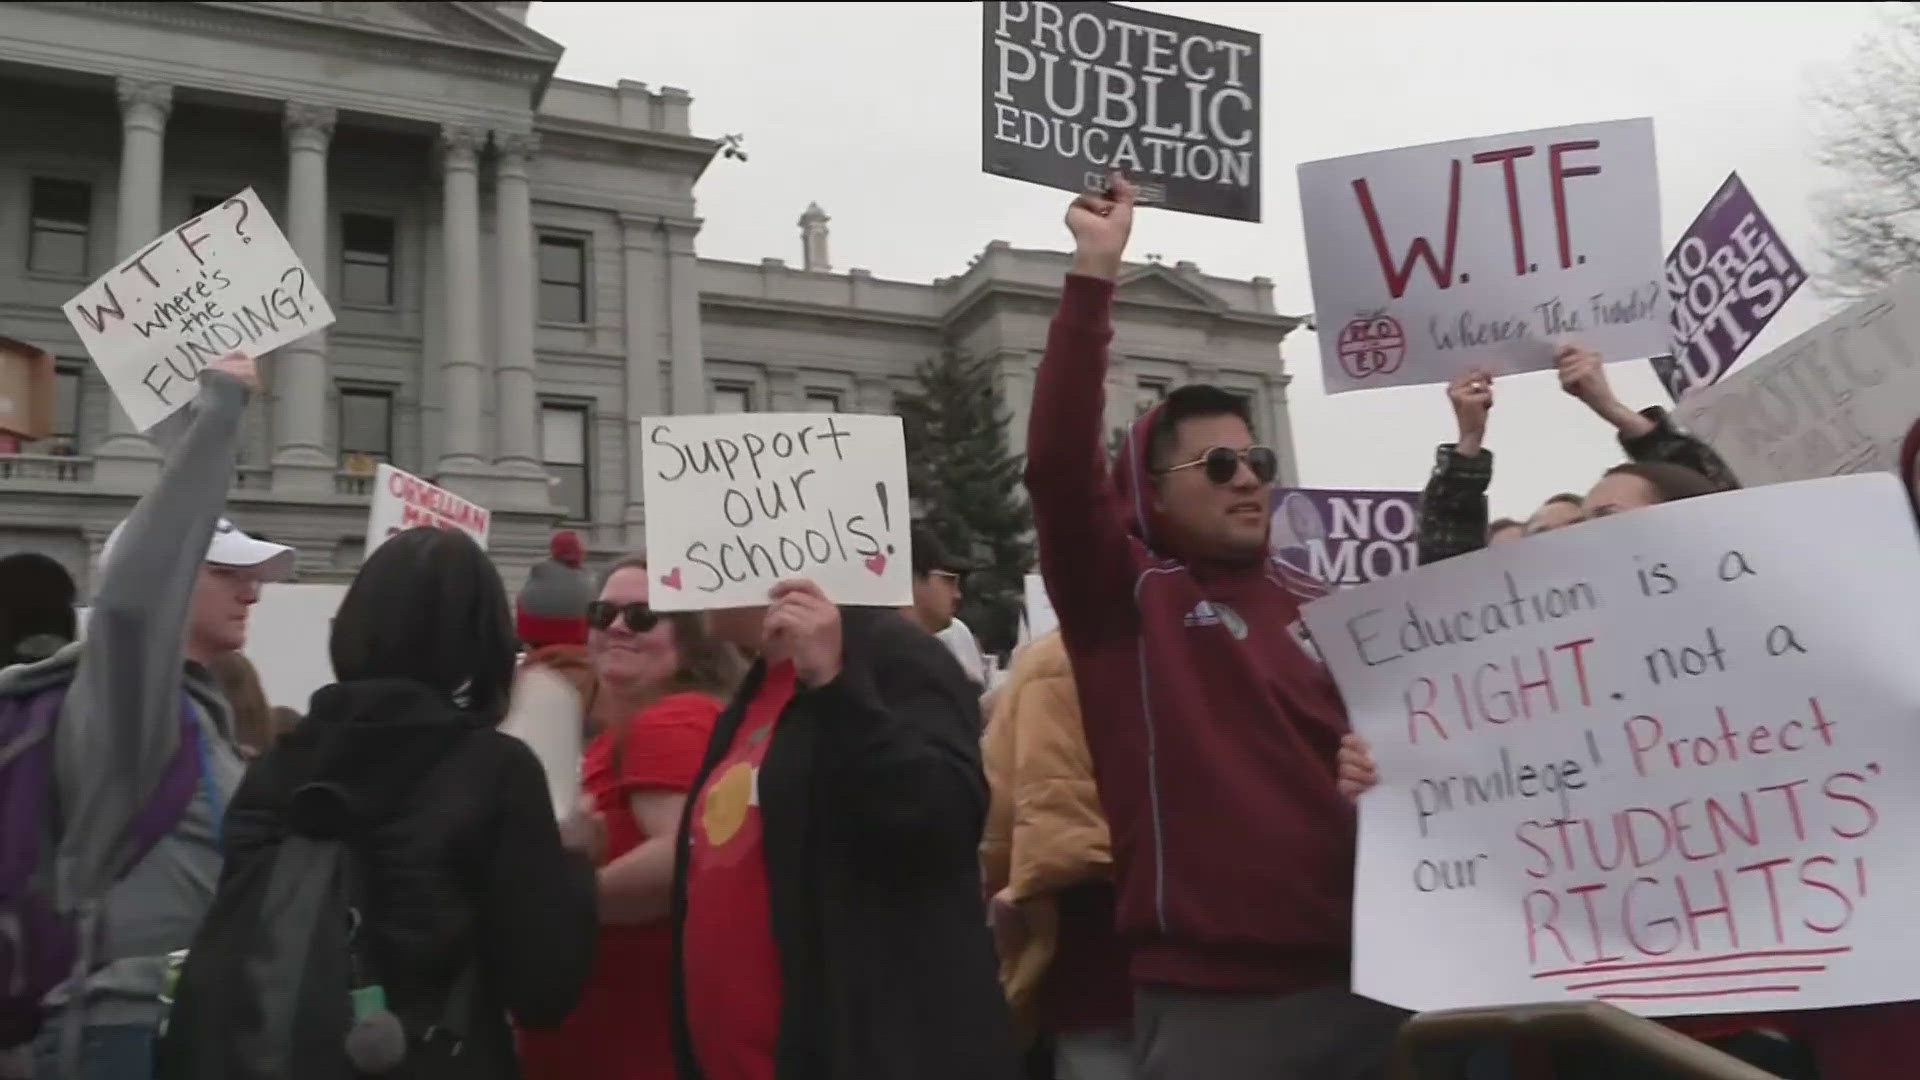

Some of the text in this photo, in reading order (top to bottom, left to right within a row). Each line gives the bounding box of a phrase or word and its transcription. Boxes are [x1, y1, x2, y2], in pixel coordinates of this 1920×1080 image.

[994, 2, 1252, 87] PROTECT
[994, 38, 1253, 147] PUBLIC
[994, 101, 1253, 187] EDUCATION
[1665, 236, 1707, 296] NO
[1671, 212, 1771, 343] MORE
[142, 267, 315, 406] FUNDING?
[180, 300, 225, 334] the
[651, 417, 851, 482] Support
[723, 469, 815, 527] our
[1327, 497, 1415, 541] NO
[1346, 550, 1757, 667] Education is a
[1645, 627, 1726, 685] not
[1766, 624, 1807, 656] a
[1623, 697, 1836, 777] Protect
[1413, 852, 1489, 893] our
